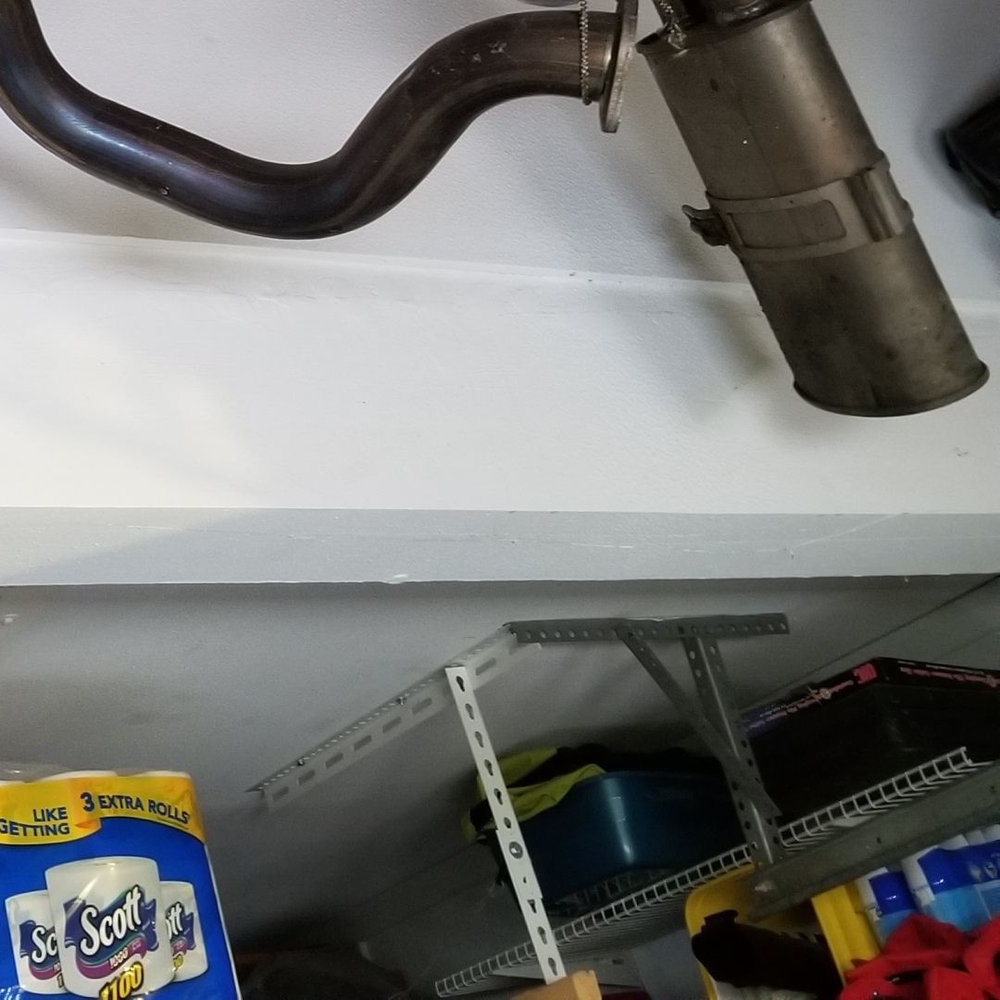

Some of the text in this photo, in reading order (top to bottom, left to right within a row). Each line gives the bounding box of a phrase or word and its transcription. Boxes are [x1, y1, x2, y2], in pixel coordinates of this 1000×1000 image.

[33, 807, 68, 822] LIKE
[80, 792, 189, 824] 3 EXTRA ROLLS
[80, 885, 142, 956] Scott
